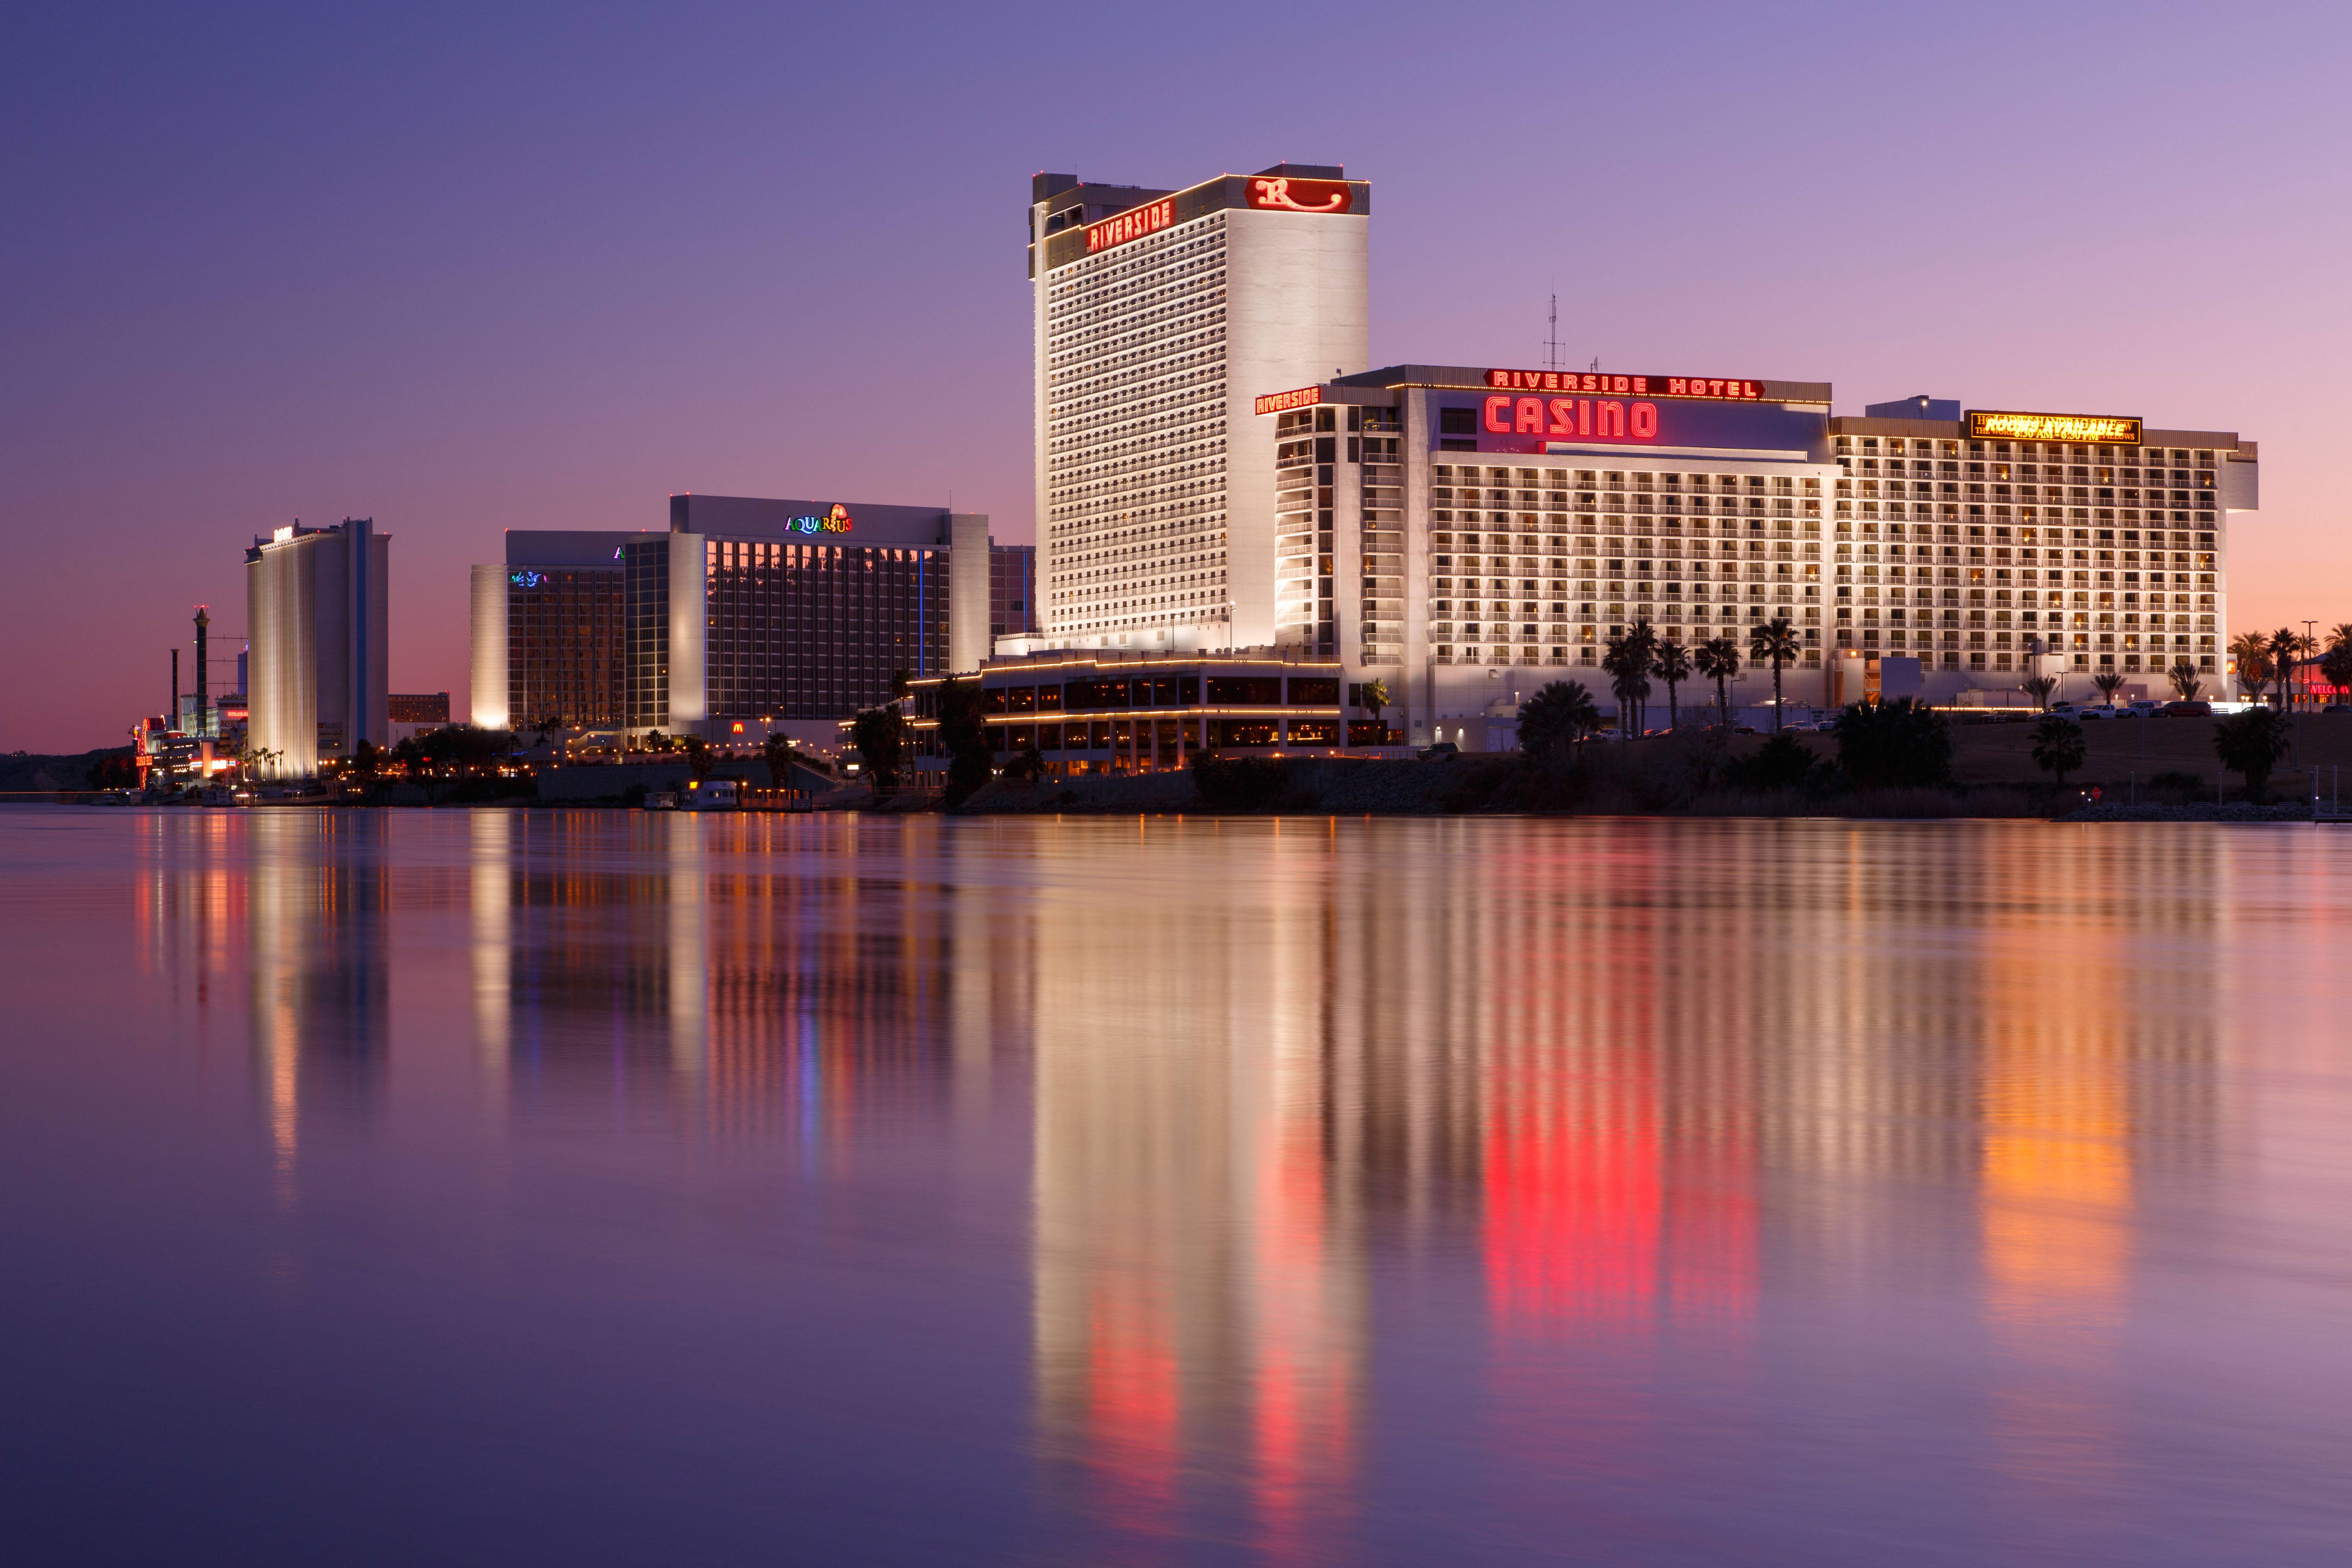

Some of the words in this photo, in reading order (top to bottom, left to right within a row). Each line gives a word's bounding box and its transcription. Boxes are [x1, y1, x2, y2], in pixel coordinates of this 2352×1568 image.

[1091, 201, 1170, 251] RIVERSIDE
[1493, 371, 1646, 392] RIVERSIDE
[1669, 379, 1757, 397] HOTEL
[1256, 387, 1320, 414] RIVERSIDE
[1486, 396, 1657, 437] CASINO
[784, 516, 852, 534] AQUARIUS
